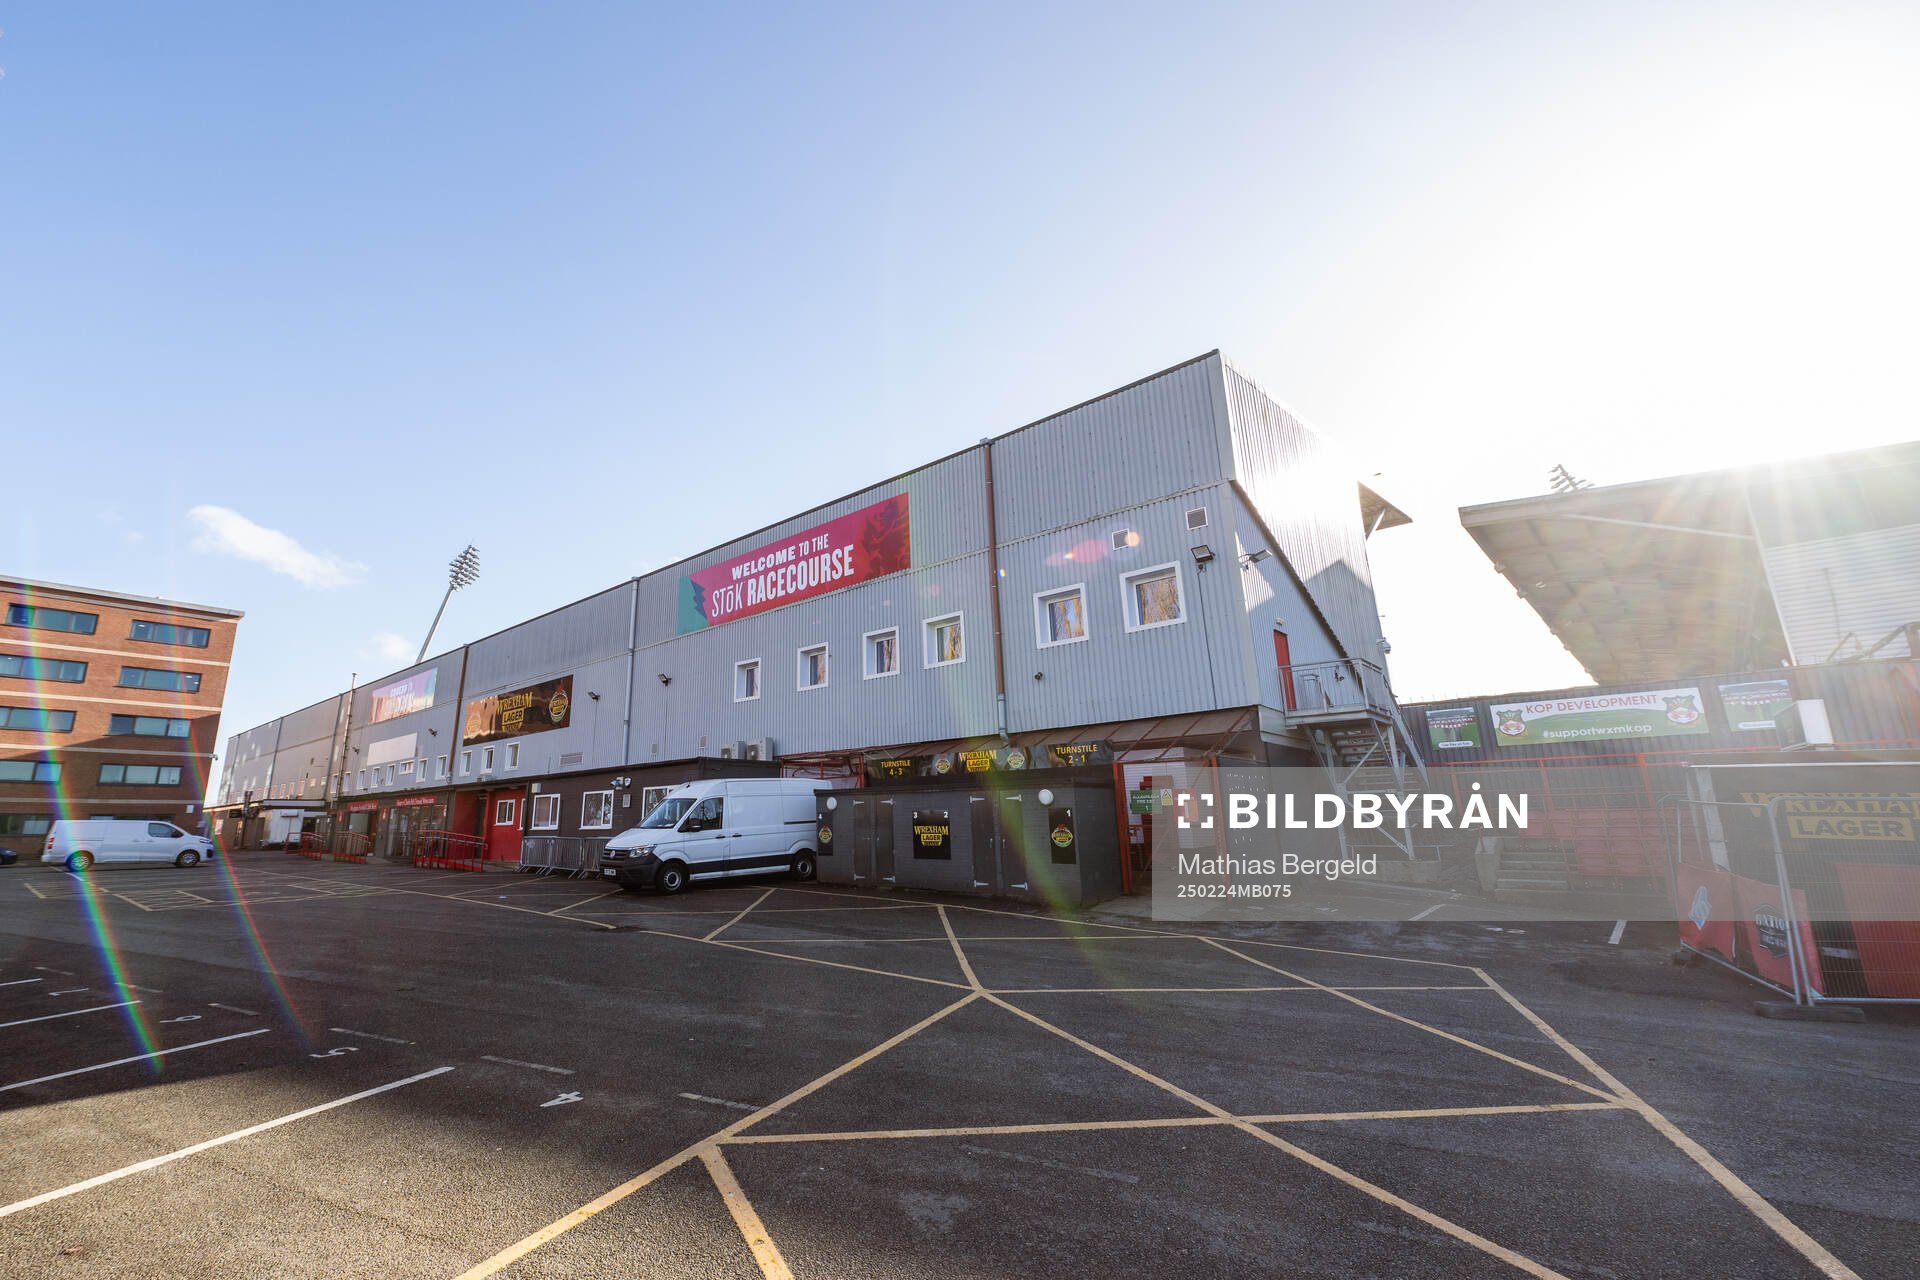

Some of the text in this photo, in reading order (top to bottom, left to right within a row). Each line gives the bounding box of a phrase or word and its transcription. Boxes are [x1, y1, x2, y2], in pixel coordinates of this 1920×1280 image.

[731, 533, 829, 580] WELCOME TO THE
[747, 544, 854, 606] RACECOURSE
[496, 691, 534, 715] WREXHAM
[1525, 694, 1658, 715] KOP DEVELOPMENT
[503, 710, 524, 724] LAGER
[1542, 723, 1653, 739] #supportwxmkop
[959, 750, 997, 762] WREXHAM
[1055, 744, 1098, 755] TURNSTILE
[880, 759, 911, 768] TURNSTILE
[913, 811, 918, 819] 3
[943, 811, 949, 819] 2
[1066, 809, 1072, 817] 1
[913, 825, 949, 836] WREXHAM
[1796, 820, 1906, 838] LAGER
